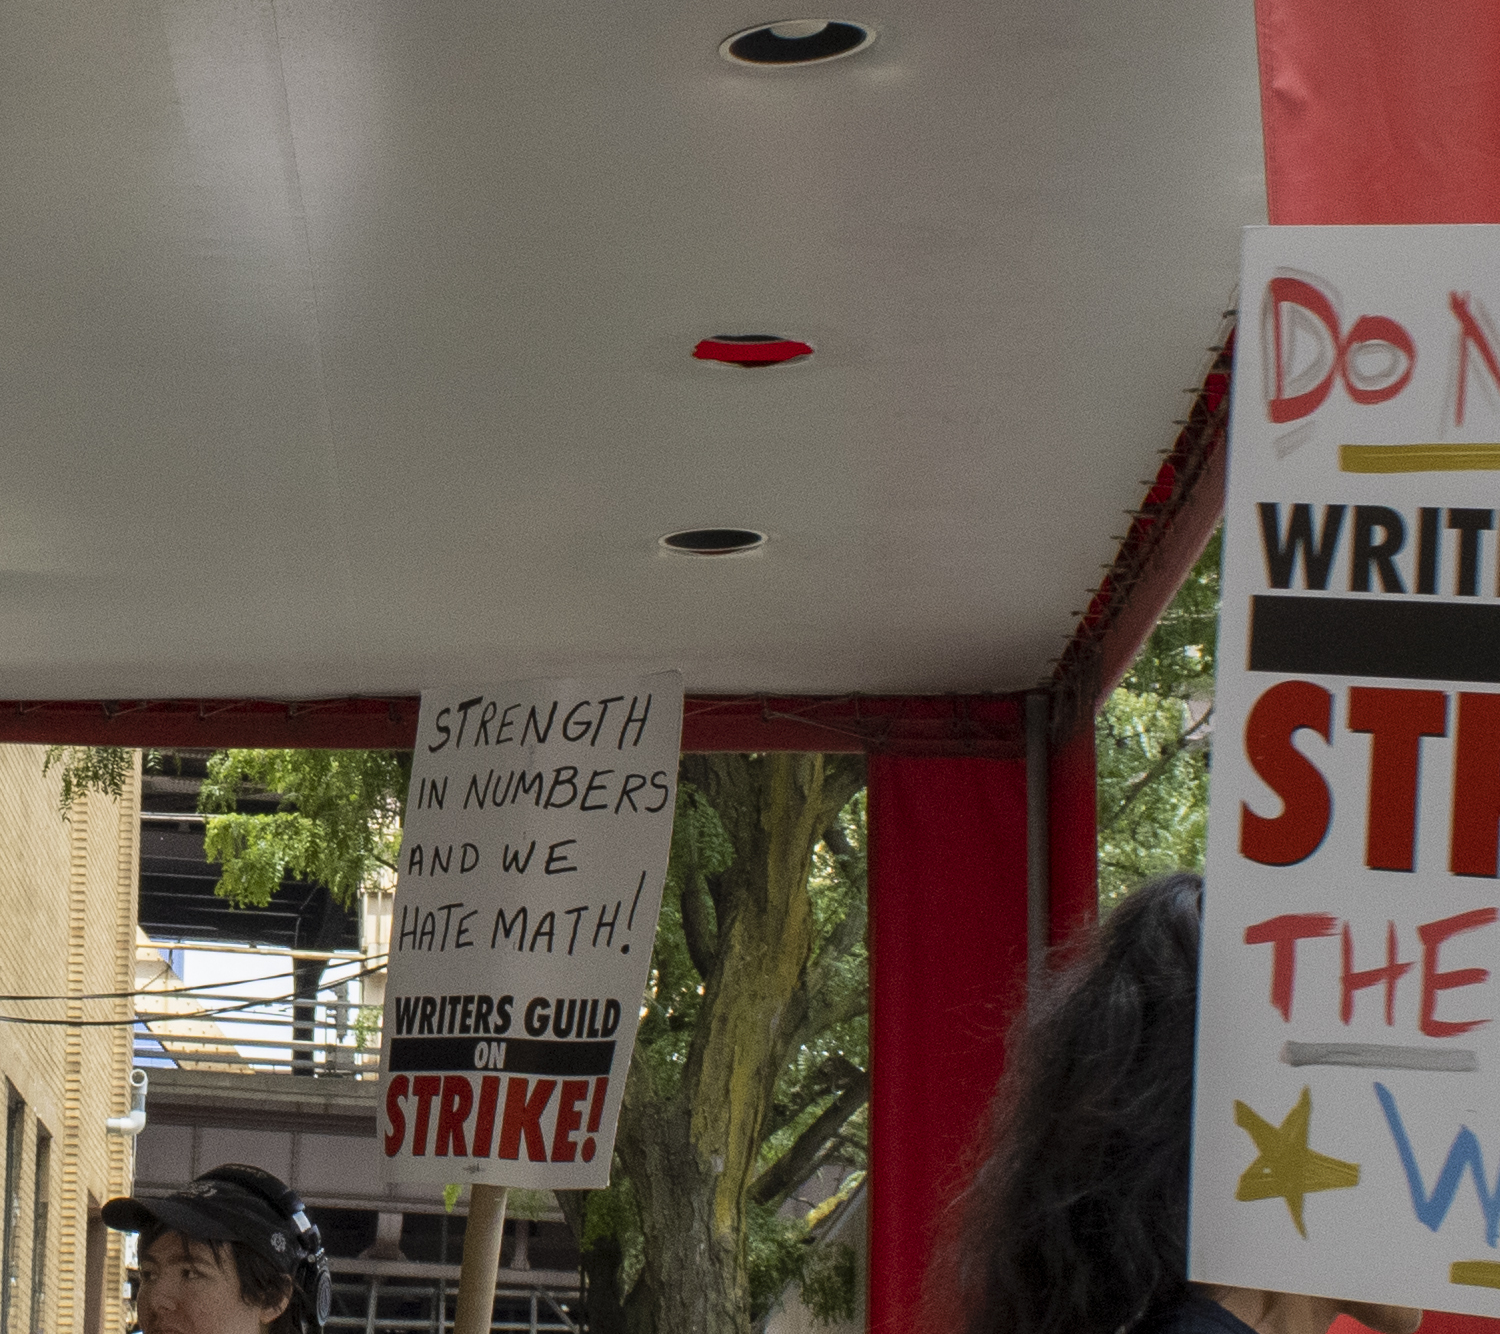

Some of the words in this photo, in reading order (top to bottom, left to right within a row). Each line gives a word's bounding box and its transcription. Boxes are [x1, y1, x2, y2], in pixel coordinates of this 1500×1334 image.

[428, 692, 653, 752] STRENGTH
[417, 776, 449, 810] IN
[463, 766, 669, 815] NUMBERS
[408, 843, 480, 877] AND
[502, 839, 578, 875] WE
[399, 902, 479, 952] HATE
[491, 870, 646, 956] MATH!
[1244, 906, 1500, 1038] THE
[395, 994, 514, 1036] WRITERS
[524, 996, 621, 1039] GUILD
[473, 1040, 506, 1070] ON
[384, 1074, 609, 1163] STRIKE!
